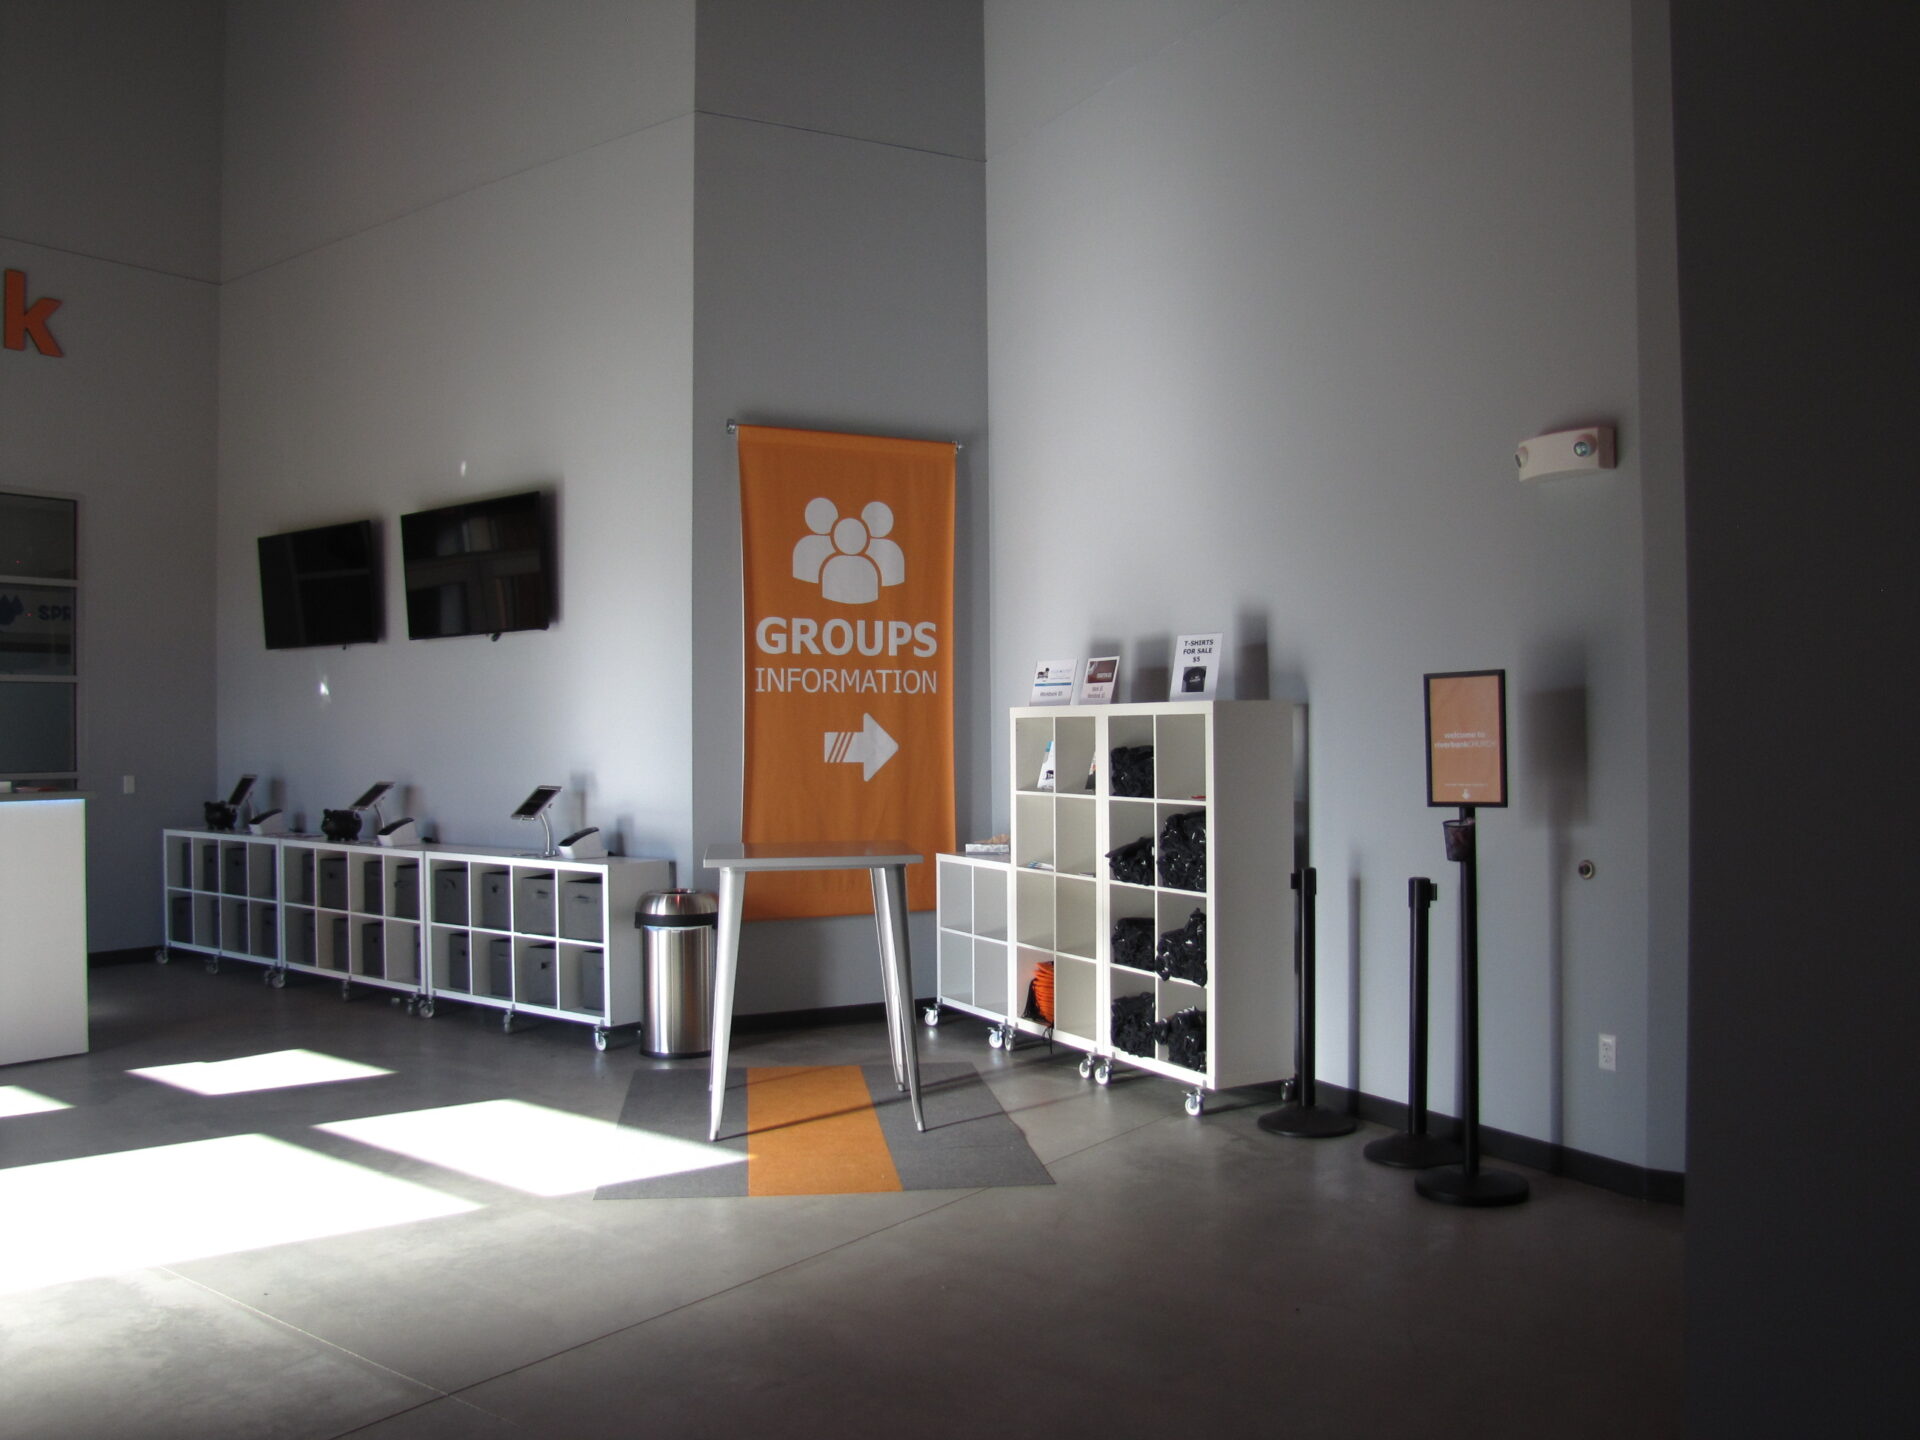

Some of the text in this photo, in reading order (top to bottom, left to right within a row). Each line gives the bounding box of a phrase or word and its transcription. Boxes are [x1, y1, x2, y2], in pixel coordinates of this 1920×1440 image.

[755, 616, 938, 658] GROUPS
[1184, 639, 1214, 647] T-SHIRTS
[754, 667, 937, 695] INFORMATION
